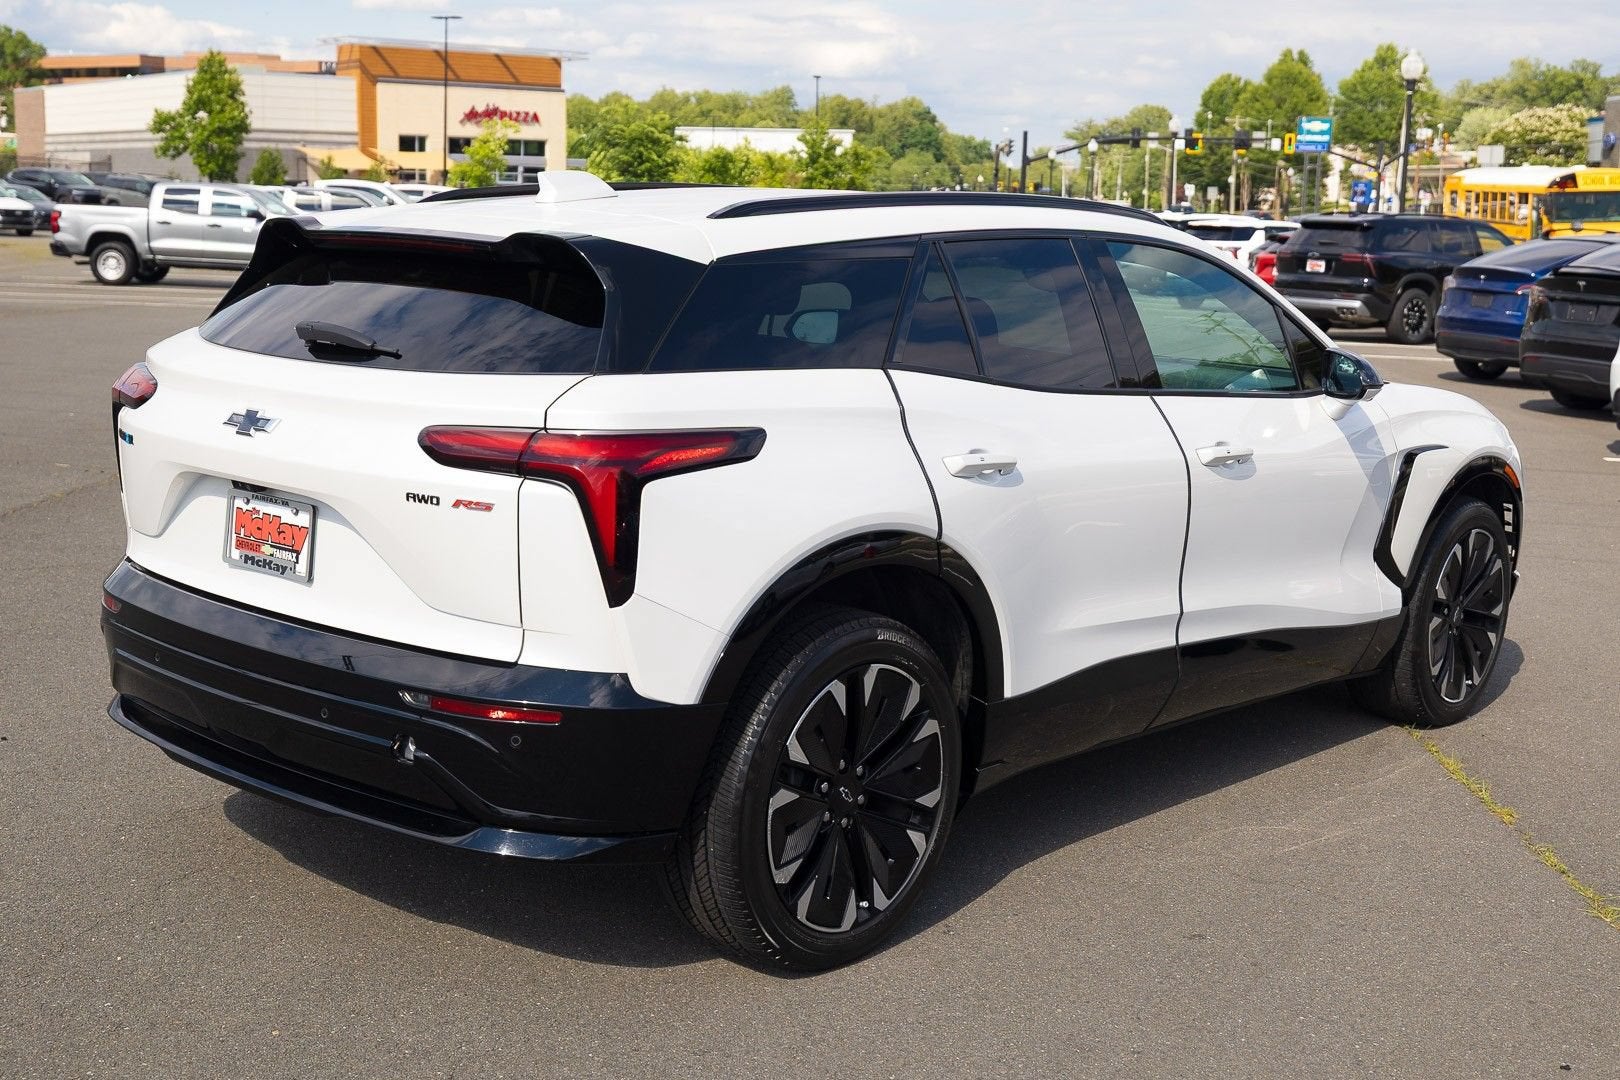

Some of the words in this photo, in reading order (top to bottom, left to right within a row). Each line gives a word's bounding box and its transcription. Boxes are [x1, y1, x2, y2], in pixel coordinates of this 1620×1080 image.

[499, 109, 541, 125] PIZZA
[451, 499, 495, 512] RS
[235, 506, 309, 555] McKay
[243, 553, 288, 575] McKay
